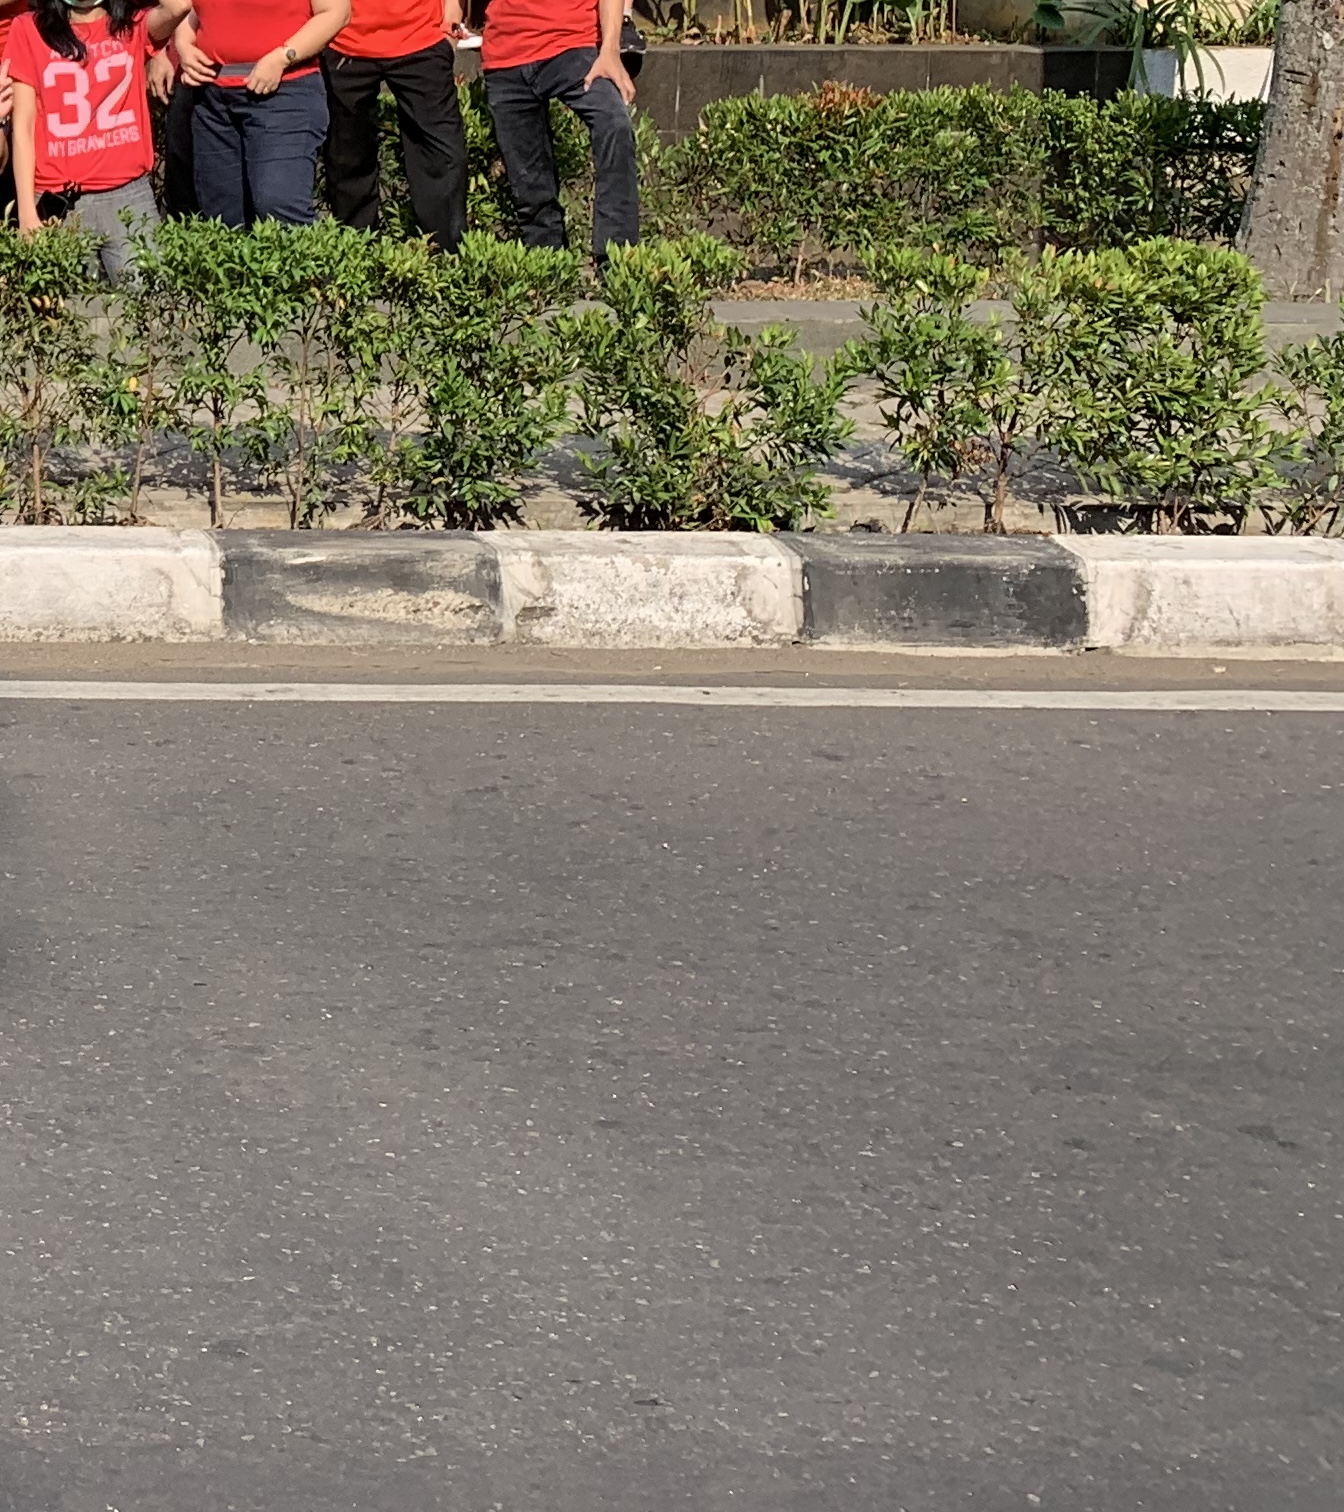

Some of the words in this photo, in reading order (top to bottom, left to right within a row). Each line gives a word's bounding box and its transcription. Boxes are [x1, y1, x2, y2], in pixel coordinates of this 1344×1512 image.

[43, 50, 136, 139] 32
[48, 141, 65, 158] NY
[67, 126, 140, 157] BRAWLERS
